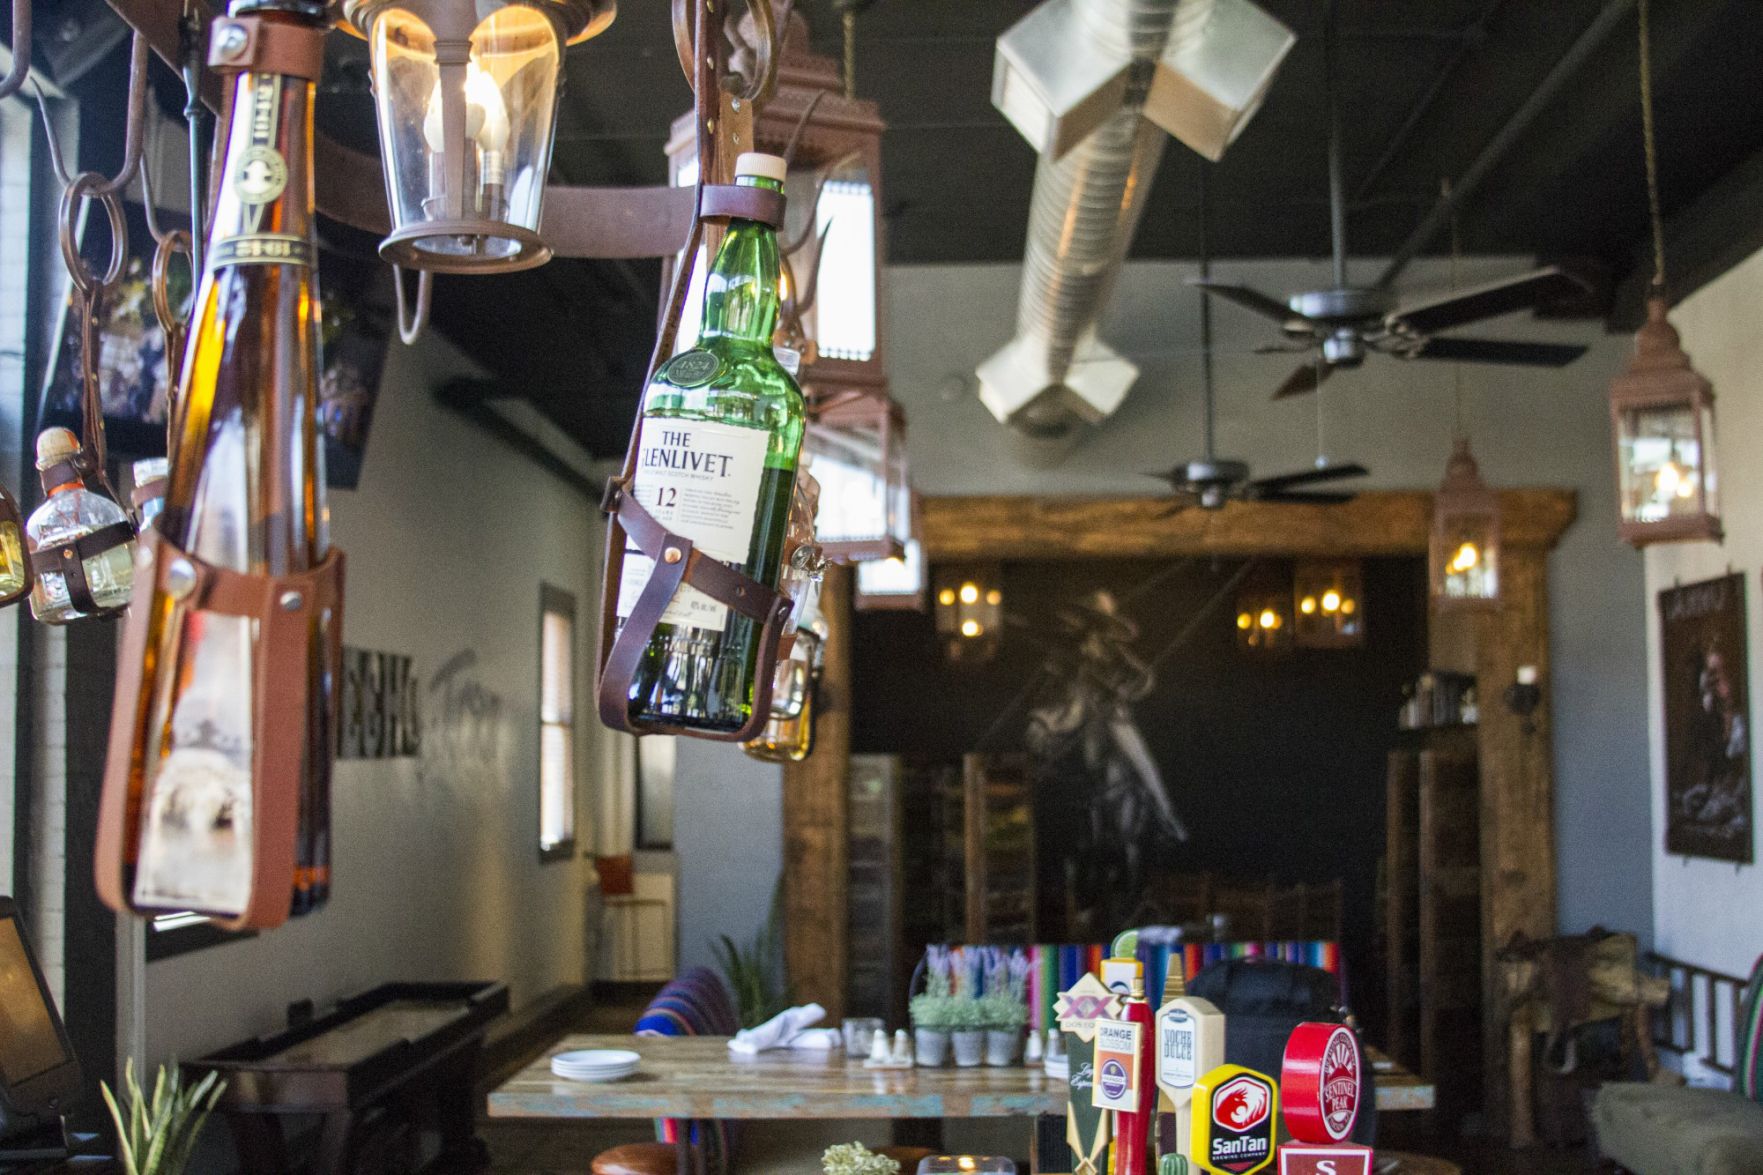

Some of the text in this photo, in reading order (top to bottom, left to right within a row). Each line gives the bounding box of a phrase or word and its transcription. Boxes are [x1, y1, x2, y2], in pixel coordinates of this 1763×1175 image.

[662, 431, 692, 447] THE
[656, 487, 677, 508] 12
[1325, 1082, 1354, 1102] SENTINEL
[1332, 1096, 1348, 1111] PEAK
[1212, 1136, 1267, 1155] SanTan
[1316, 1160, 1337, 1175] S
